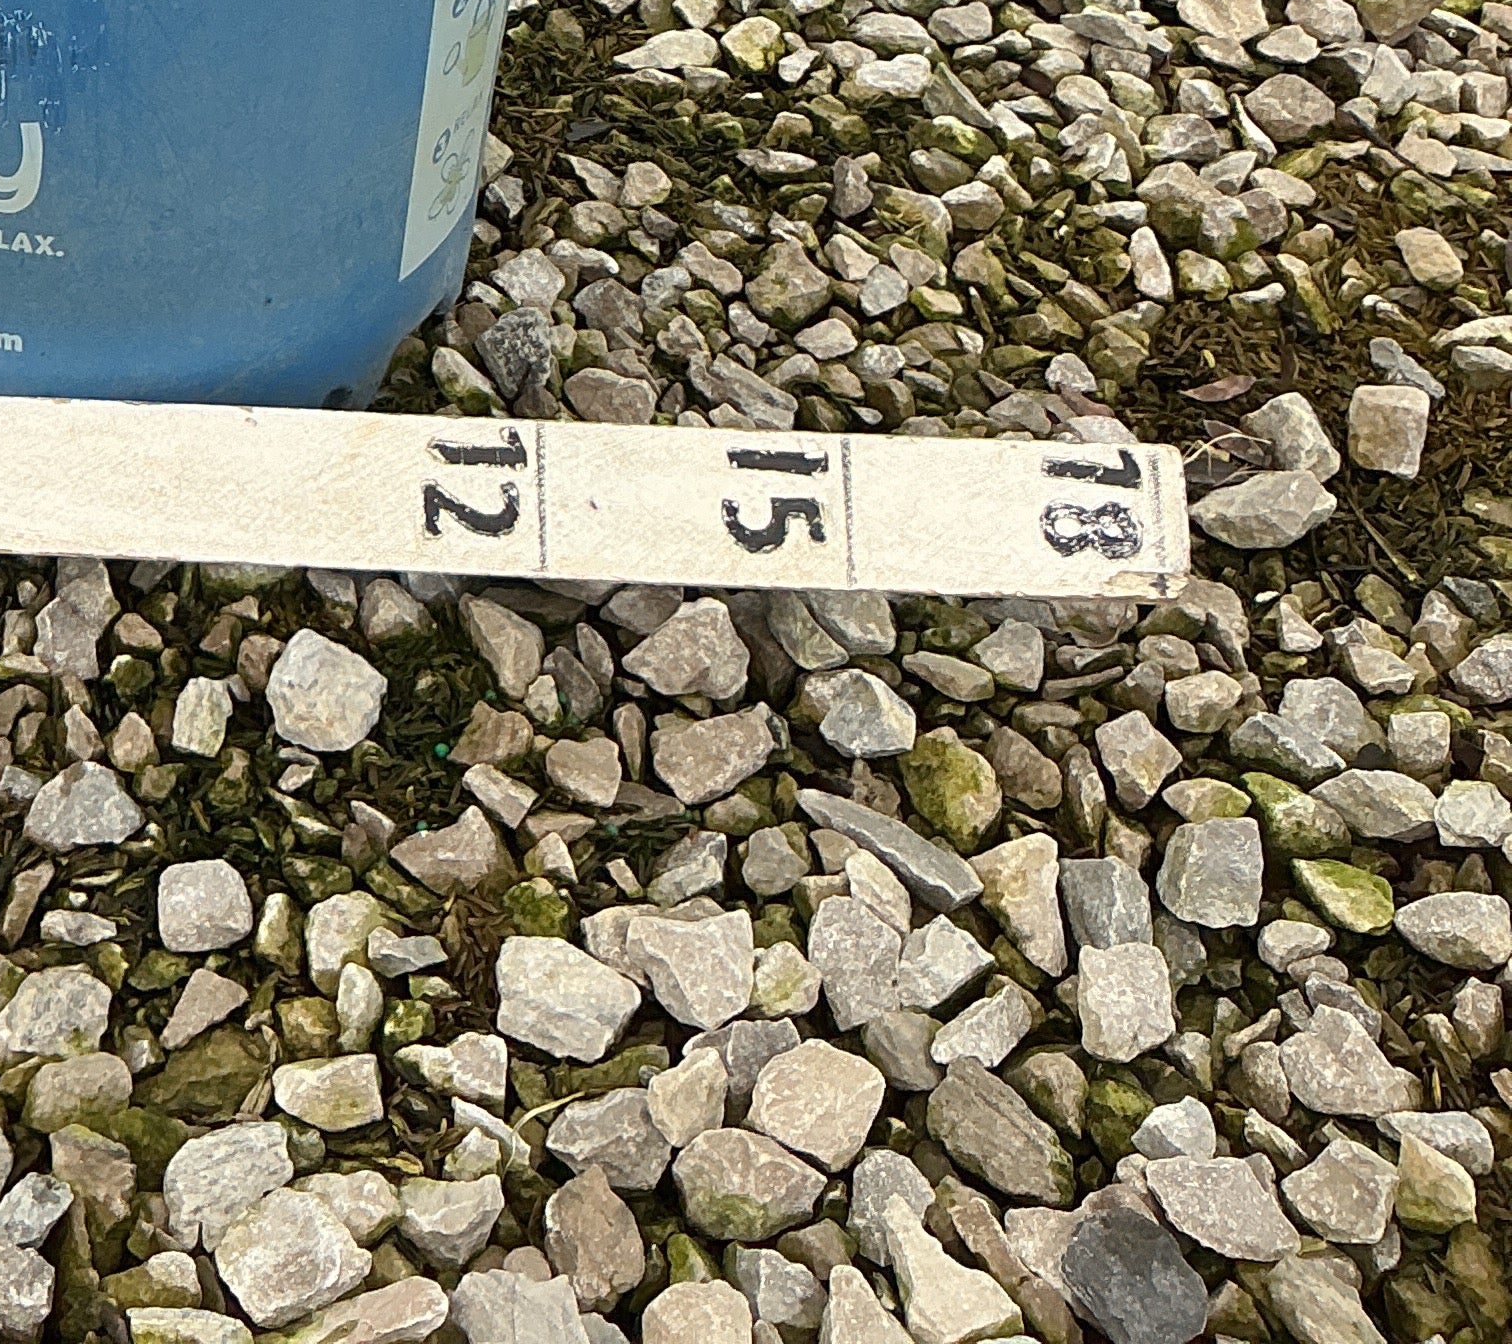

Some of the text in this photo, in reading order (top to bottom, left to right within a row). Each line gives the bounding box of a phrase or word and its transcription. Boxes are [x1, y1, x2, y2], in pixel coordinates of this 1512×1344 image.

[420, 426, 529, 539] 12
[722, 445, 829, 554] 15
[1040, 449, 1144, 560] 18
